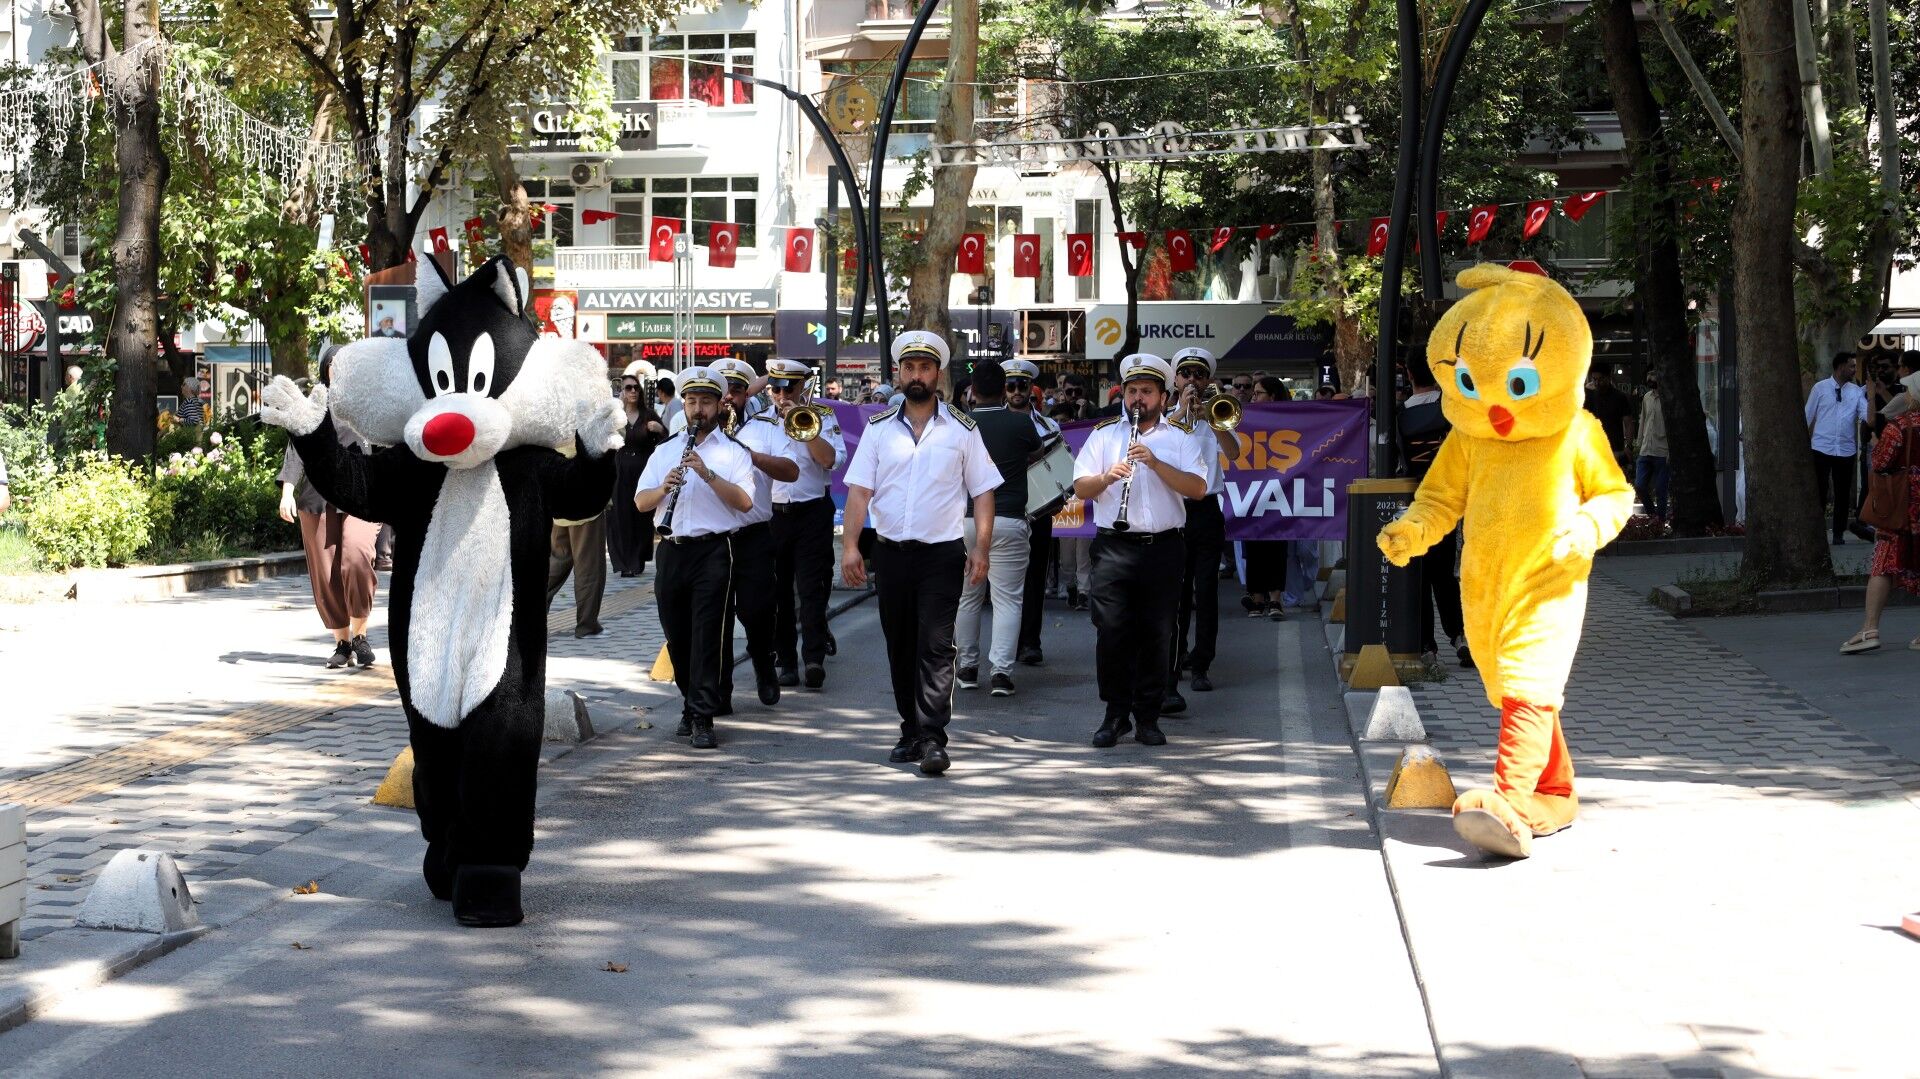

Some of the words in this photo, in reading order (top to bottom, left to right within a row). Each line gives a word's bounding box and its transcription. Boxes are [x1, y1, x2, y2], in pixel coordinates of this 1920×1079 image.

[584, 292, 647, 308] ALYAY
[641, 321, 672, 333] FABER
[1136, 324, 1215, 339] URKCELL
[1254, 332, 1294, 341] ERHANLAR
[642, 344, 674, 357] ALYAY
[1217, 478, 1335, 518] VALİ
[1376, 501, 1396, 510] 2023
